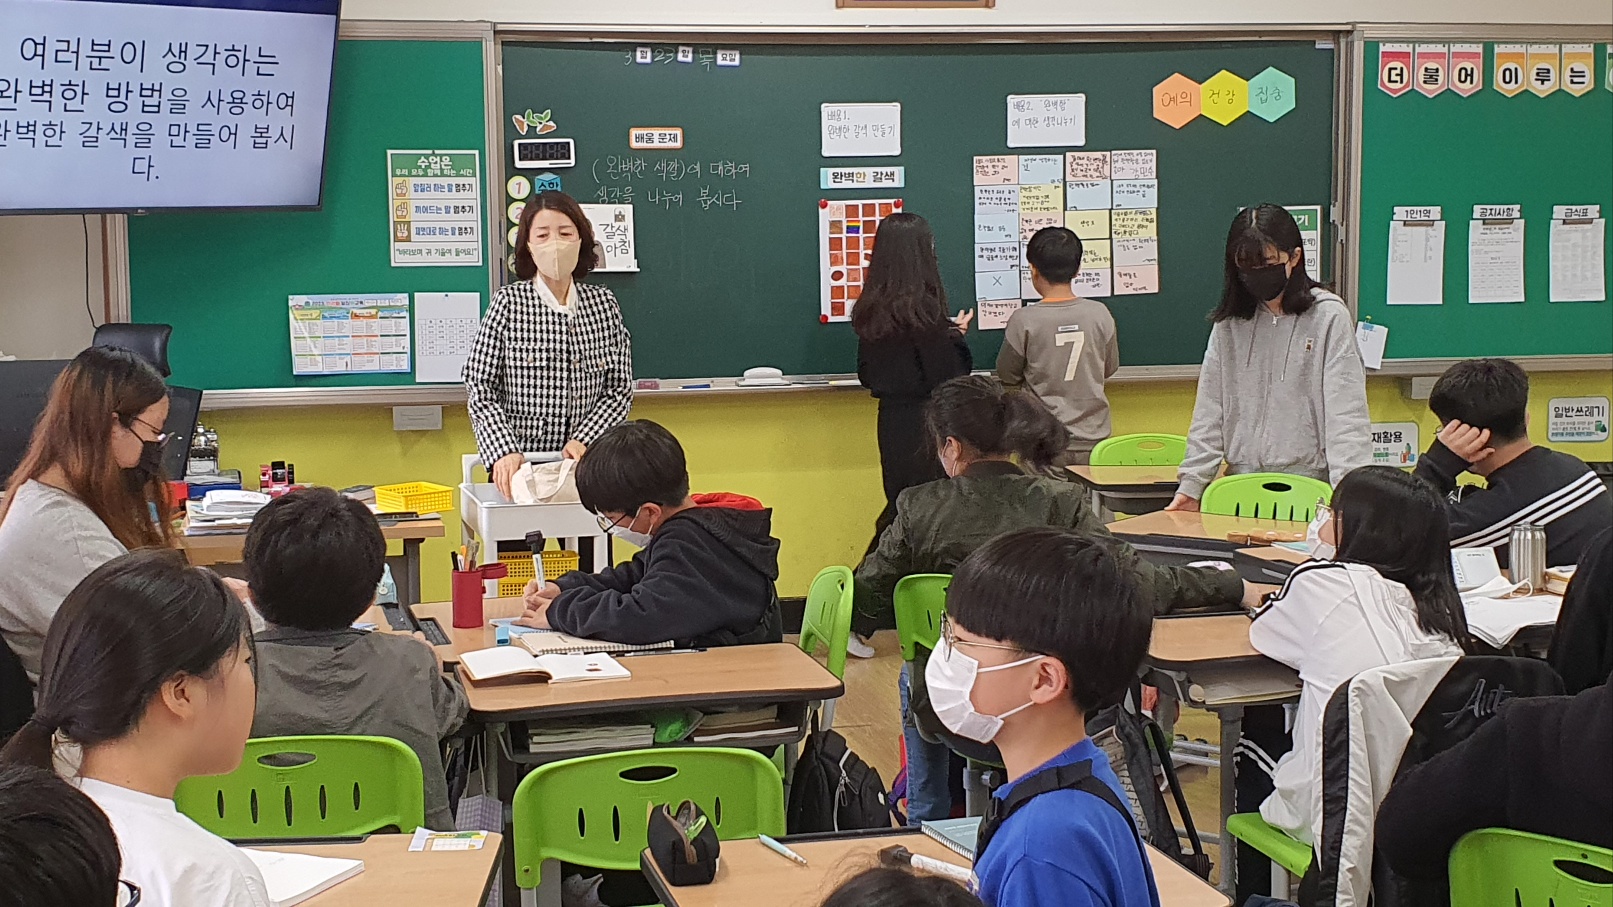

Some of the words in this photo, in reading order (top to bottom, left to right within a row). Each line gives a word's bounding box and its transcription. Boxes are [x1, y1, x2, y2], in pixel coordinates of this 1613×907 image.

[20, 36, 146, 73] 여러분이
[162, 41, 280, 77] 생각하는
[653, 47, 675, 64] 23
[720, 53, 737, 63] 요일
[1387, 67, 1474, 85] 더불어
[1502, 67, 1586, 85] 이루는
[105, 81, 190, 115] 방법을
[201, 88, 295, 117] 사용하여
[1161, 91, 1192, 107] 예의
[1208, 88, 1236, 105] 건강
[79, 121, 156, 149] 갈색을
[168, 122, 239, 150] 만들어
[250, 123, 296, 150] 봅시
[634, 132, 655, 143] 배움
[658, 132, 678, 144] 문제
[827, 124, 850, 139] 완벽한
[853, 124, 868, 138] 갈색
[871, 124, 895, 138] 만들기
[132, 155, 159, 182] 다.
[417, 156, 453, 169] 수업은
[709, 160, 749, 179] 대하여
[443, 168, 457, 176] 하는
[460, 168, 473, 176] 시간
[831, 171, 867, 183] 완벽한
[872, 170, 895, 182] 갈색
[433, 183, 446, 193] 하는
[455, 183, 473, 193] 멈추기
[697, 185, 742, 211] 봅시다
[415, 205, 443, 214] 끼어드는
[444, 205, 451, 214] 말
[453, 205, 474, 214] 멈추기
[1479, 207, 1514, 218] 공지사항
[1564, 208, 1589, 218] 급식표
[415, 226, 437, 236] 제멋대로
[458, 226, 474, 236] 멈추기
[599, 222, 629, 240] 갈색
[605, 238, 631, 257] 아침
[1055, 331, 1085, 381] 7
[1553, 405, 1605, 418] 일반쓰레기
[1371, 430, 1403, 443] 재활용
